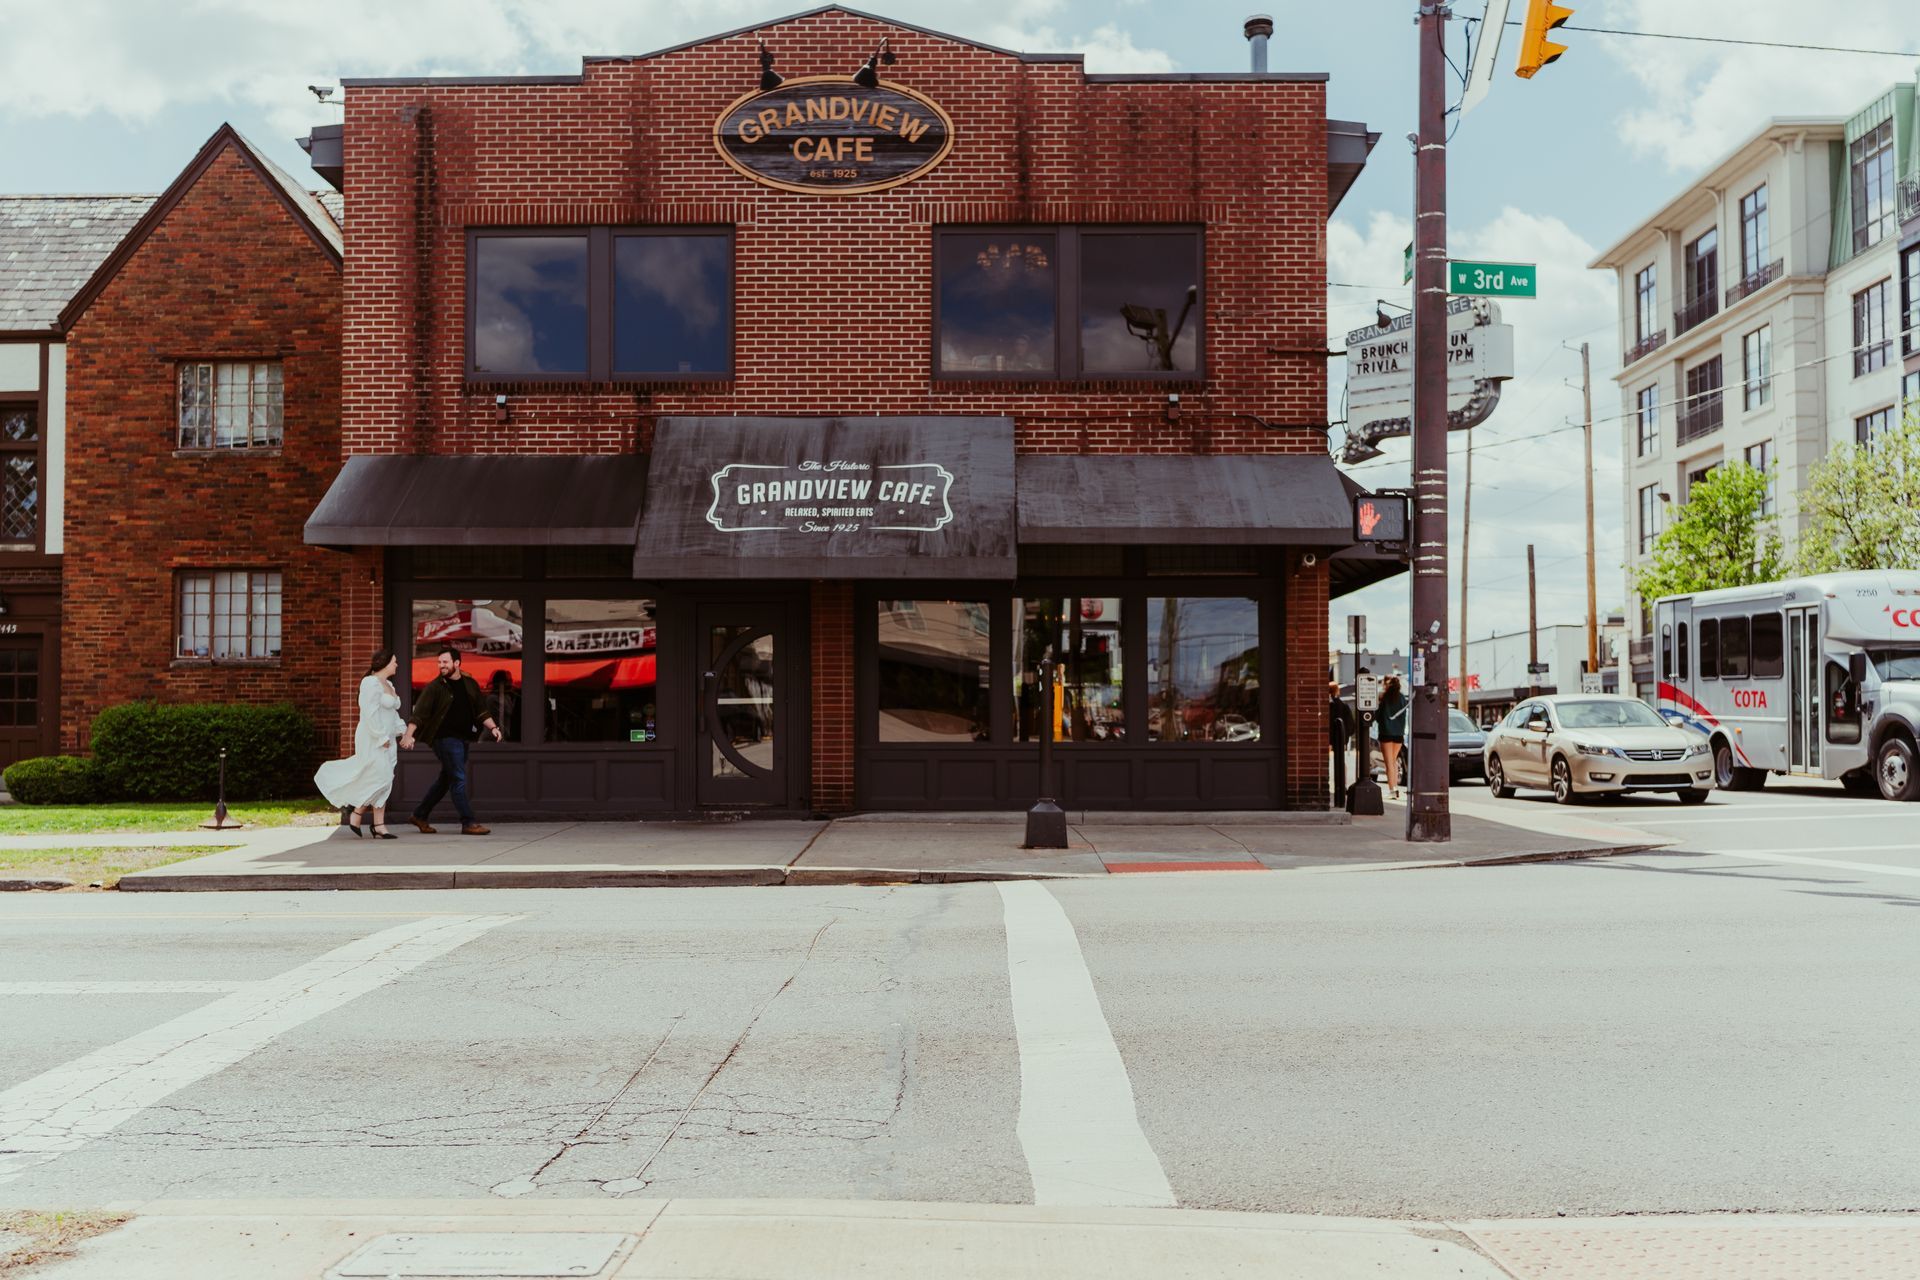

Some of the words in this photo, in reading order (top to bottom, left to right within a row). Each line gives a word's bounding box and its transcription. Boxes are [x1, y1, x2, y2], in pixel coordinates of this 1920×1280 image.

[737, 96, 930, 144] GRANDVIEW
[793, 137, 874, 162] CAFE
[833, 169, 858, 178] 1925
[1458, 273, 1467, 284] W
[1473, 269, 1504, 290] 3rd
[1510, 275, 1529, 287] Ave
[1348, 315, 1412, 343] GRANDVIE
[1446, 298, 1469, 315] AFE
[1361, 341, 1408, 359] BRUNCH
[1450, 333, 1468, 347] UN
[1356, 359, 1398, 374] TRIVIA
[798, 460, 822, 472] The
[823, 460, 870, 472] Historic
[737, 479, 872, 505] GRANDVIEW
[878, 480, 936, 506] CAFE
[785, 507, 820, 518] RELAXED,
[821, 507, 854, 517] SPIRITED
[856, 507, 874, 517] EATS
[798, 520, 830, 533] Since
[832, 523, 860, 532] 1925
[1856, 589, 1878, 598] 2250
[0, 624, 17, 634] 445
[1584, 685, 1601, 694] 25
[1734, 690, 1767, 708] COTA
